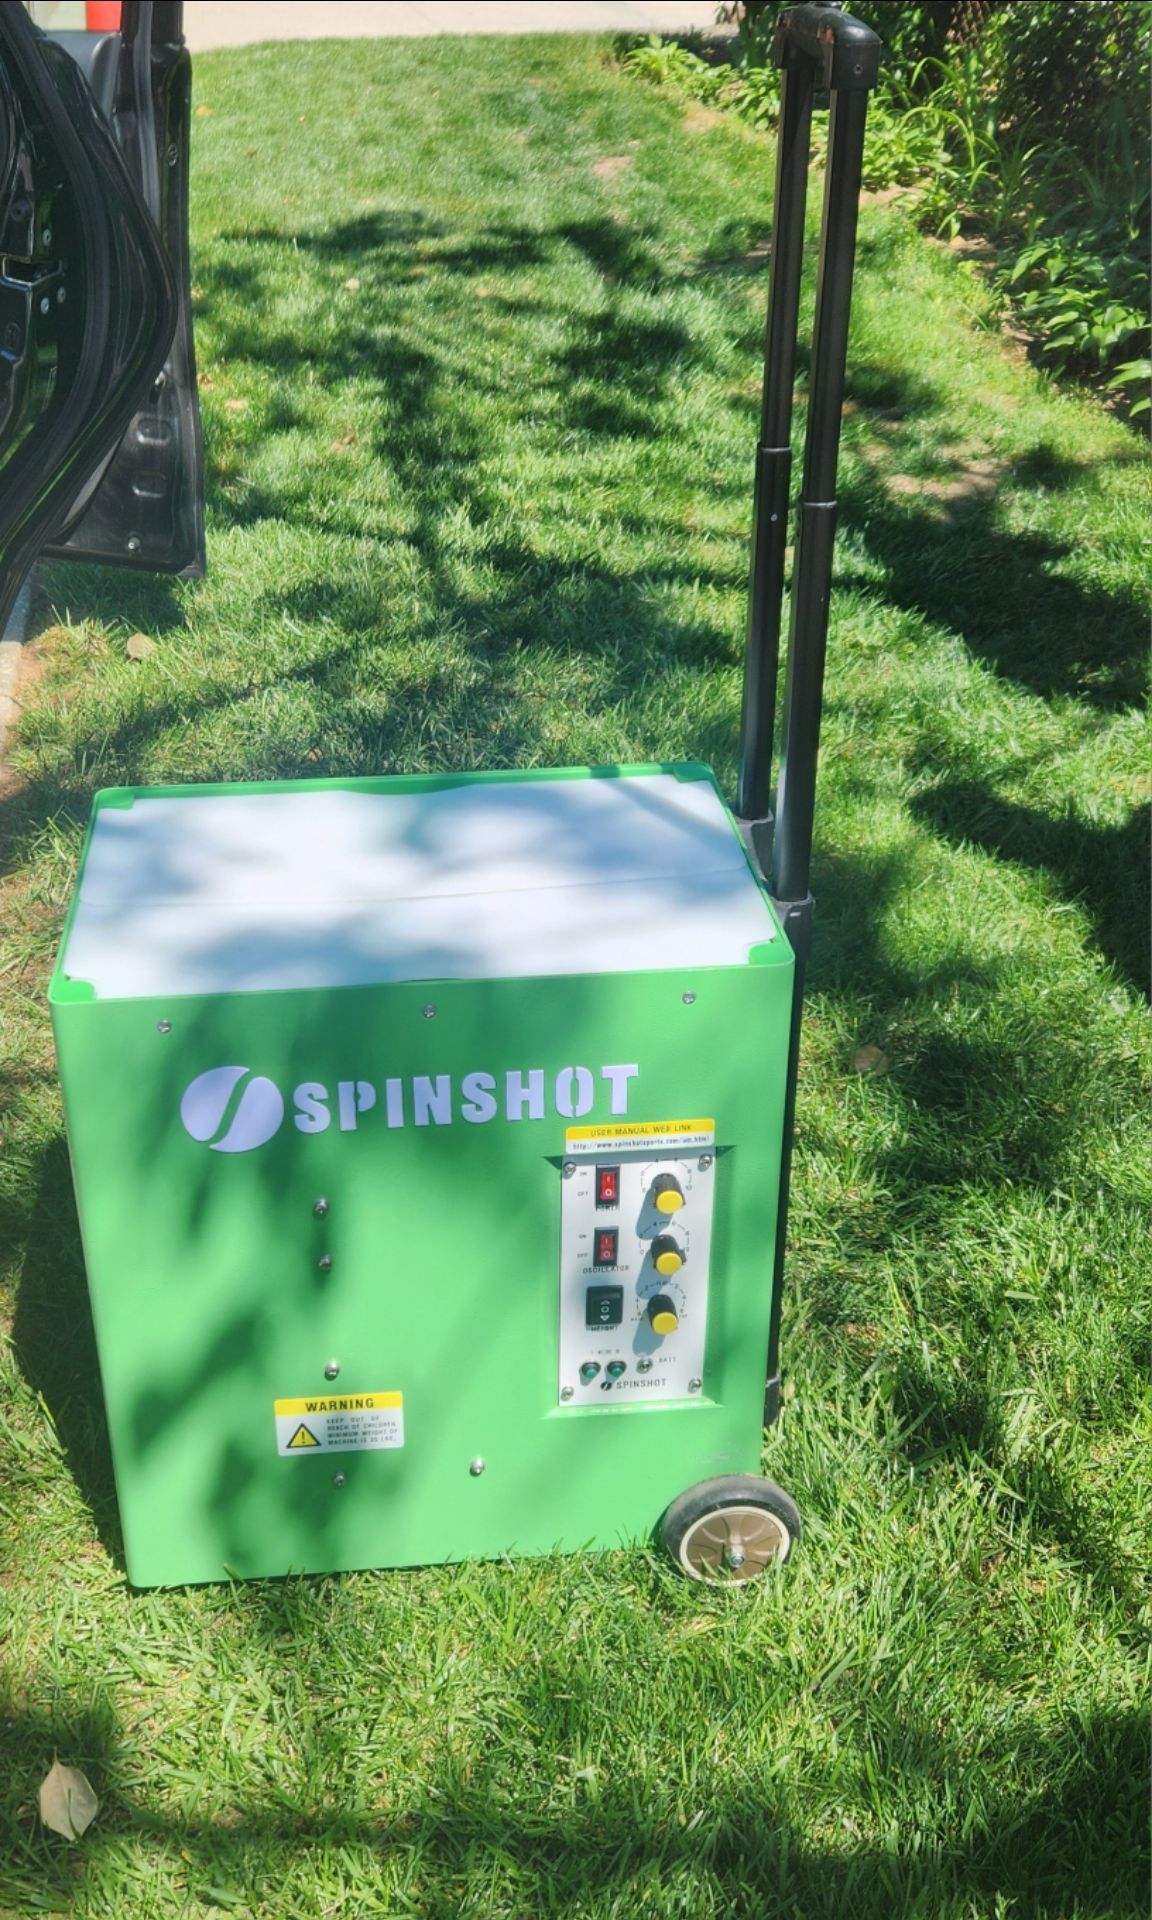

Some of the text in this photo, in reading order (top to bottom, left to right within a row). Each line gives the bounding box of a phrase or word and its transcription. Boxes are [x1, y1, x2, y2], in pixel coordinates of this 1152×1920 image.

[293, 1064, 639, 1133] SPINSHOT
[590, 1128, 612, 1137] USER
[615, 1126, 650, 1136] MANUAL
[674, 1123, 692, 1132] LINK
[616, 1378, 667, 1389] SPINSHOT
[305, 1398, 374, 1412] WARNING
[326, 1417, 344, 1425] KEEP
[363, 1421, 396, 1429] CHILDREN
[328, 1437, 358, 1445] MACHINE
